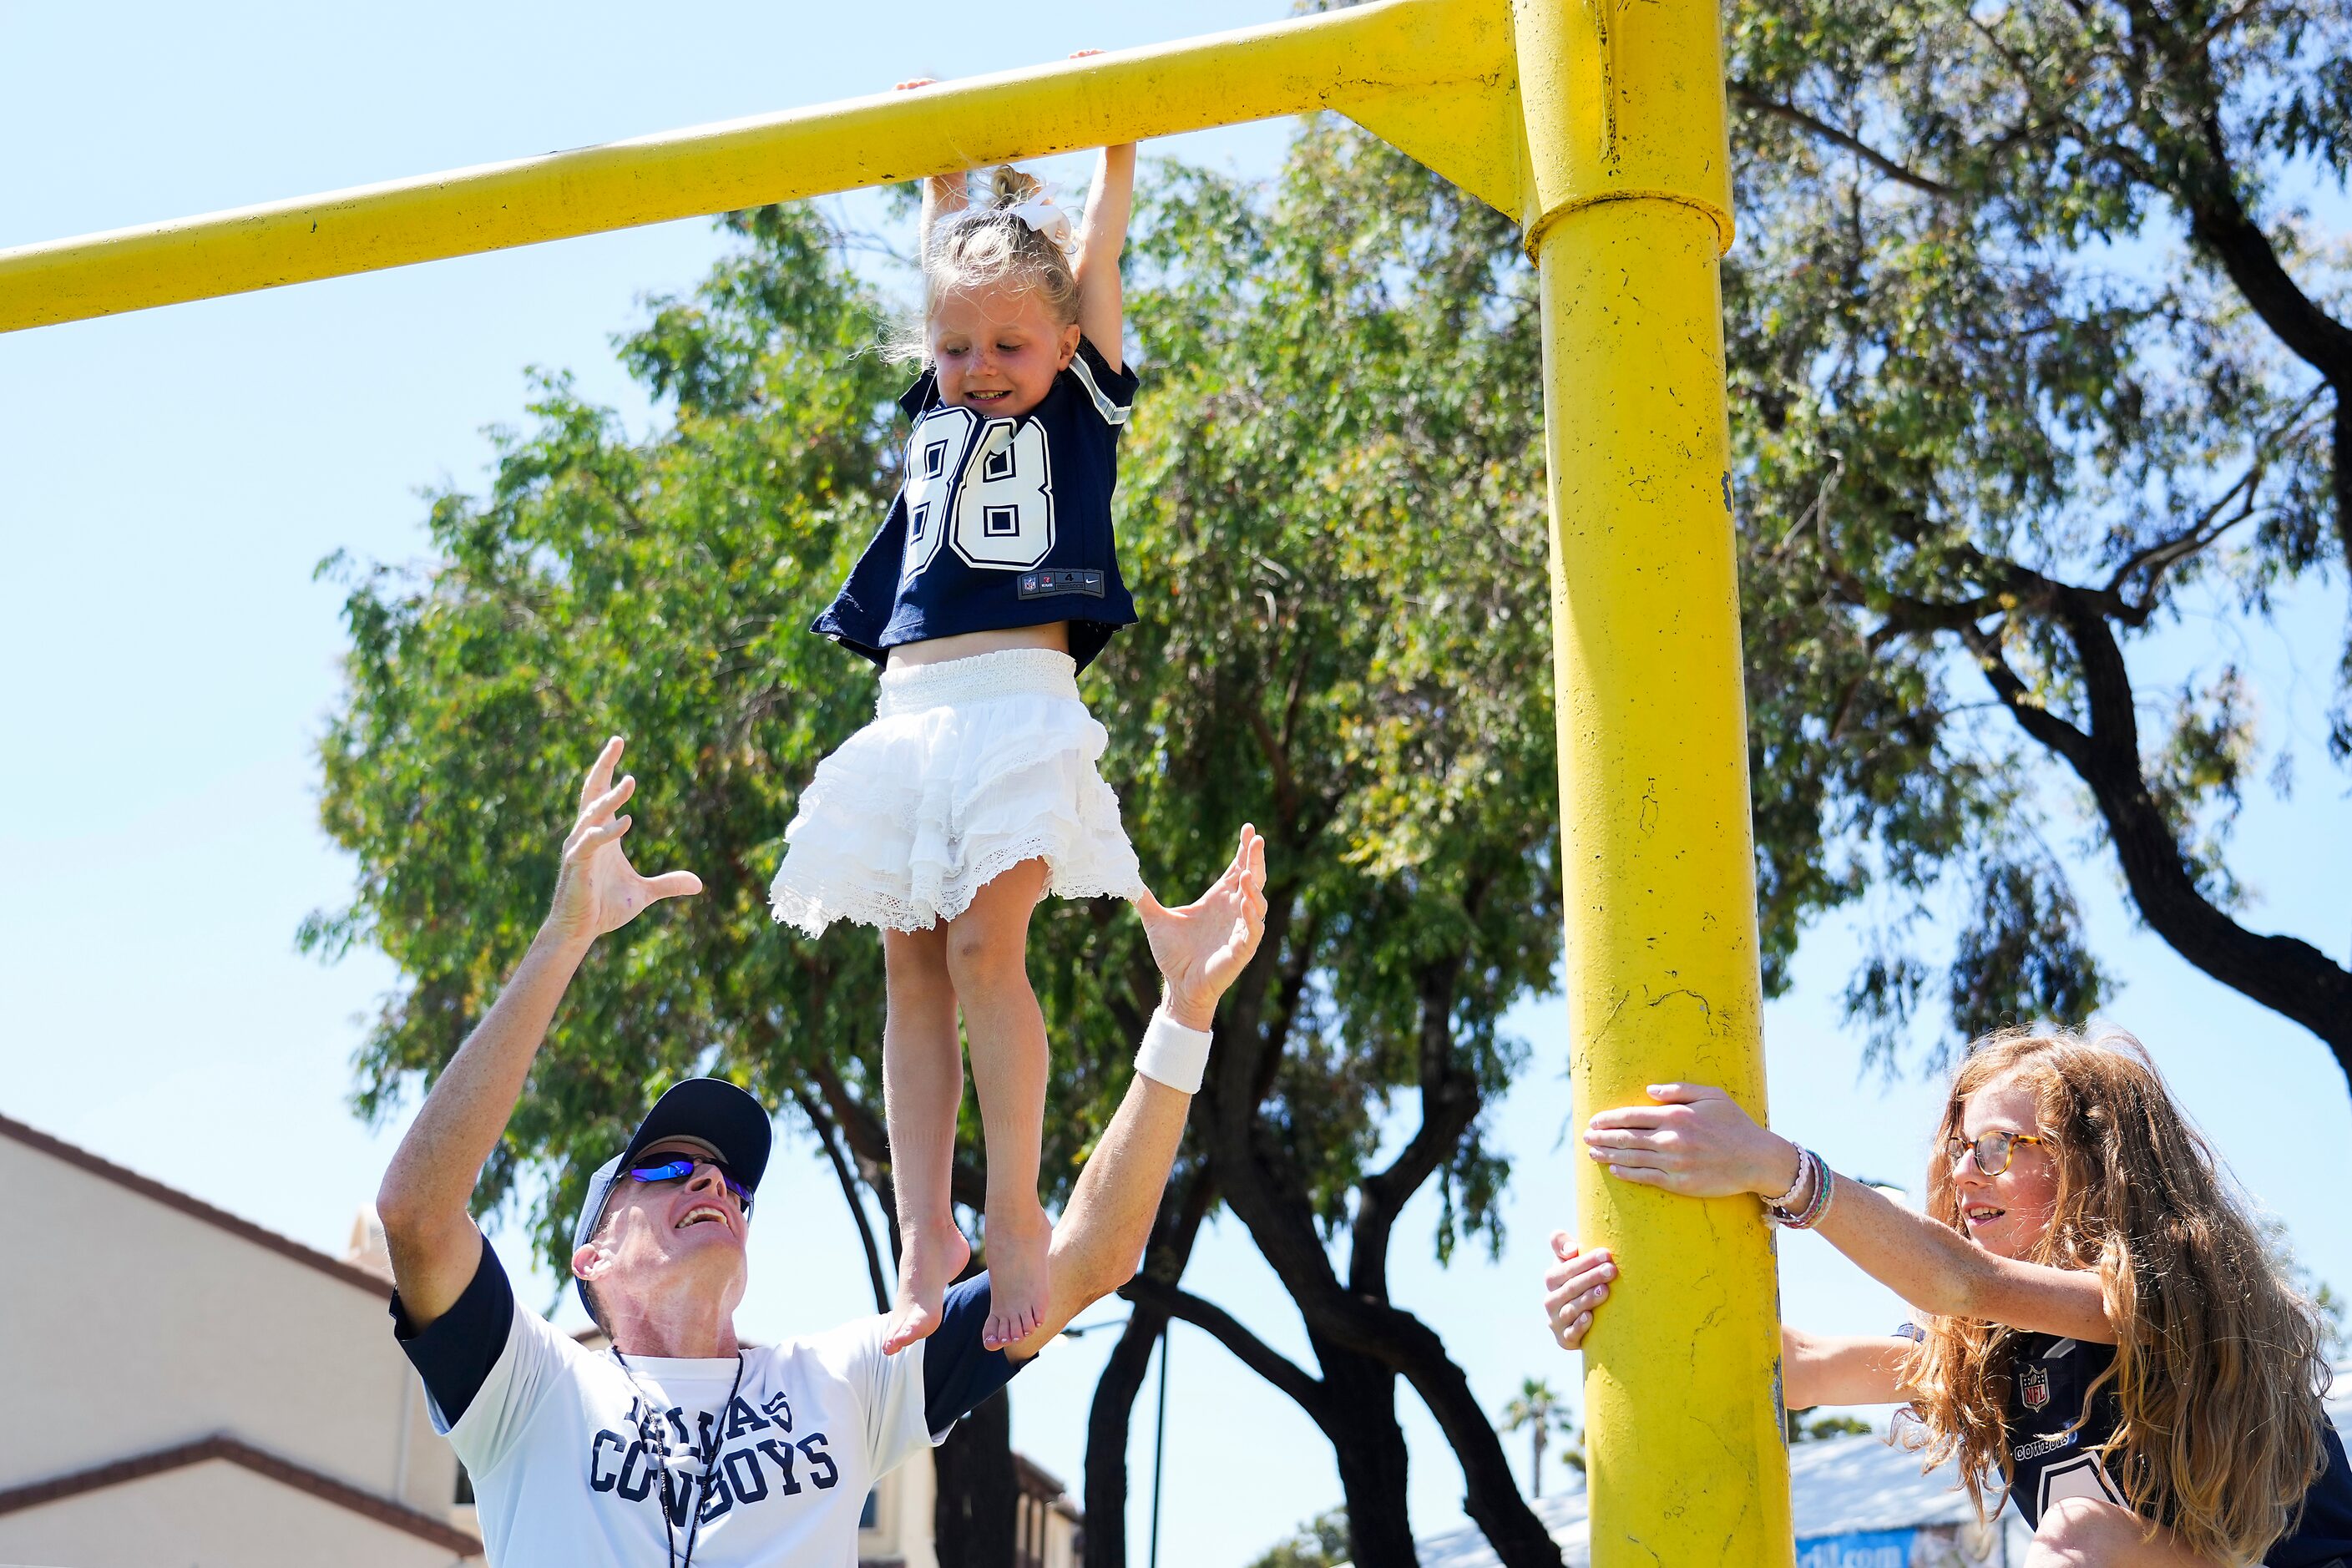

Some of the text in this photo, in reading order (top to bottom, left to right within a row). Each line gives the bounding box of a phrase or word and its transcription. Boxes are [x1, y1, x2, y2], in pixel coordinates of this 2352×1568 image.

[904, 407, 1055, 584] 88
[1065, 573, 1075, 582] 4
[2026, 1384, 2046, 1404] NFL
[590, 1429, 839, 1528] COWBOYS
